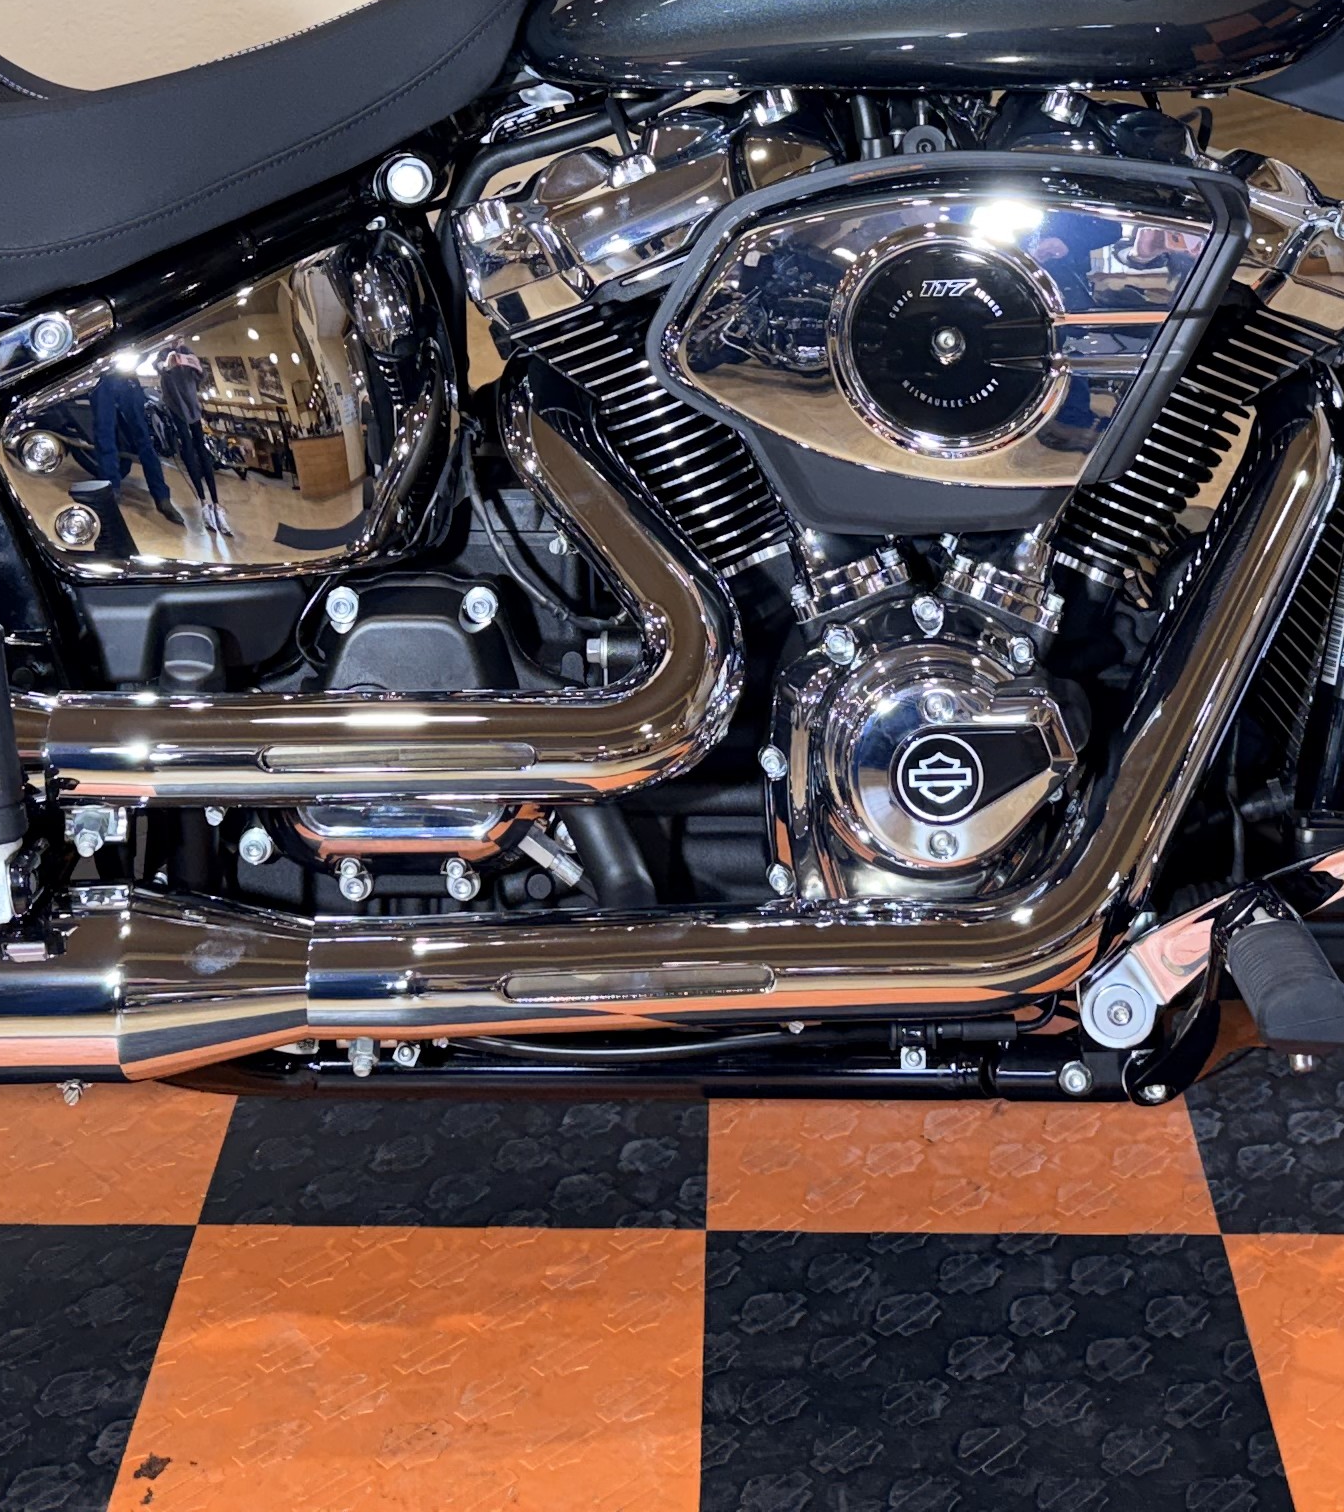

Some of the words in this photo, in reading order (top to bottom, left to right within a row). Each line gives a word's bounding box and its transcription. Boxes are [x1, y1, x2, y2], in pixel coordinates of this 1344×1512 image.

[889, 290, 914, 318] CUBIC
[919, 278, 978, 297] 117
[902, 378, 999, 408] MILWAUKEE-EIGHT
